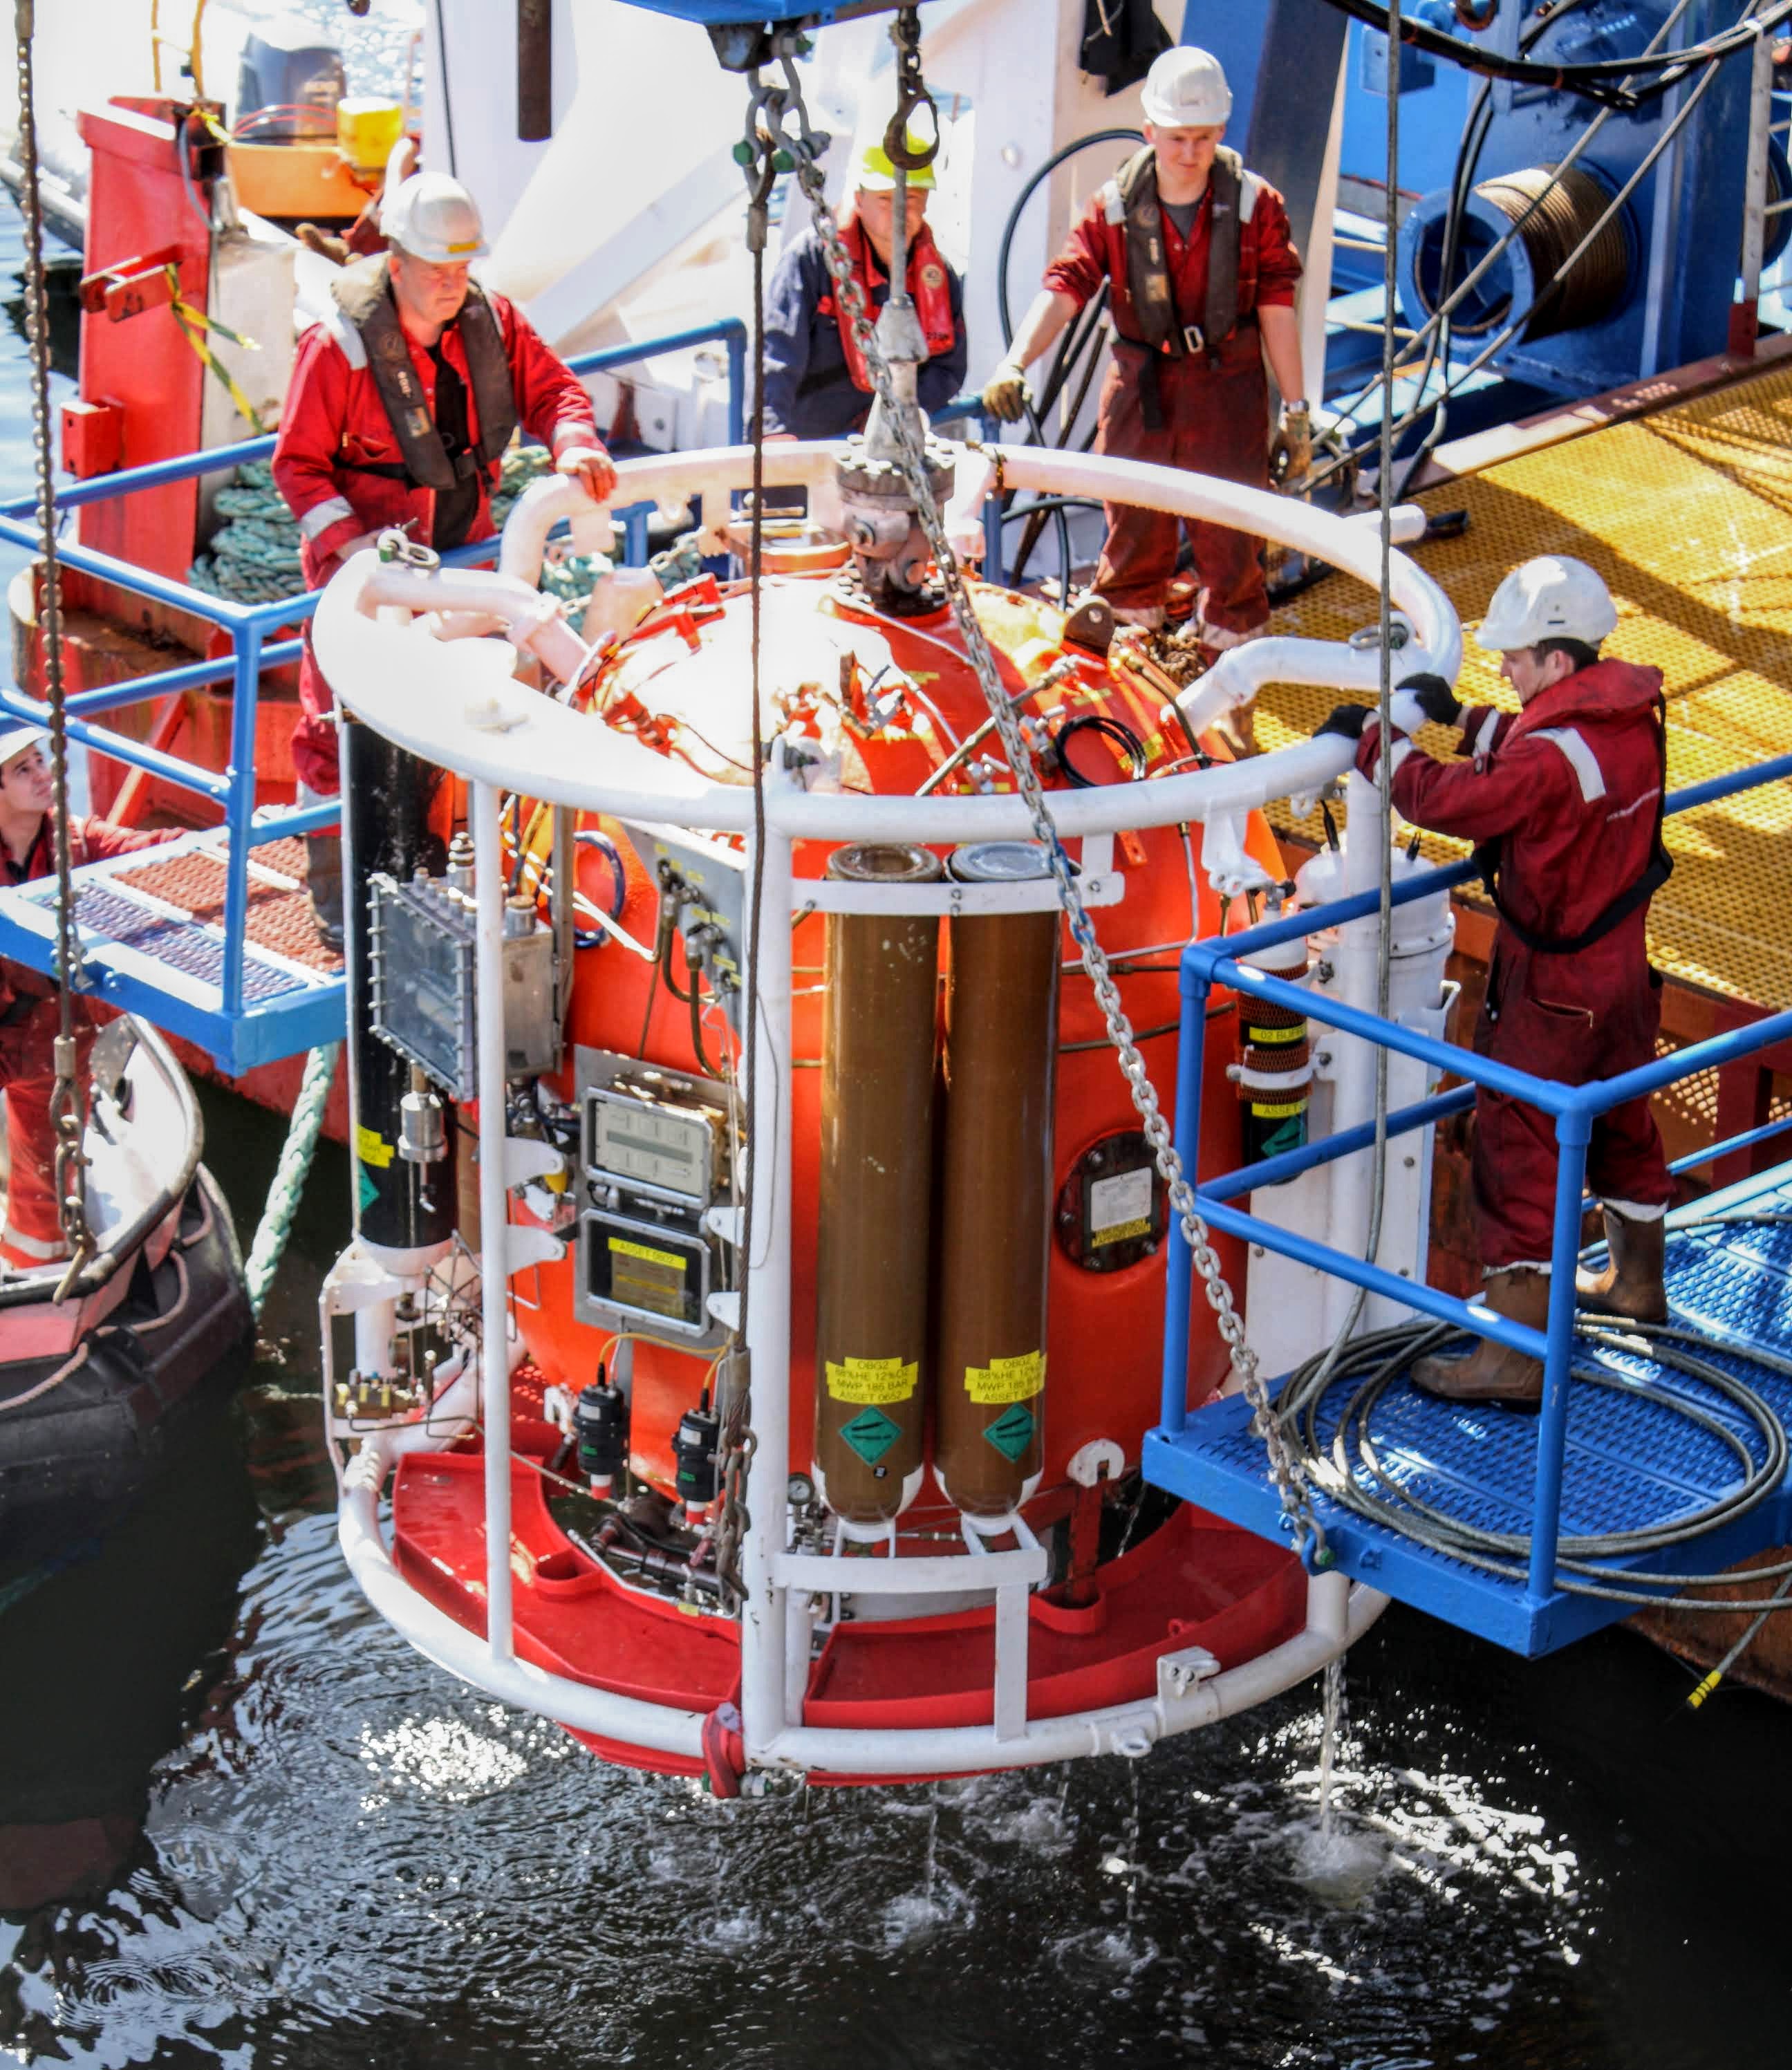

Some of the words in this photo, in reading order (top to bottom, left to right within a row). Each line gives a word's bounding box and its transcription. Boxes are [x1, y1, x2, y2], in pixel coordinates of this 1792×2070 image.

[887, 1379, 908, 1390] BAR
[976, 1382, 1005, 1391] MWP
[839, 1390, 877, 1401] ASSET
[984, 1390, 1018, 1401] ASSET
